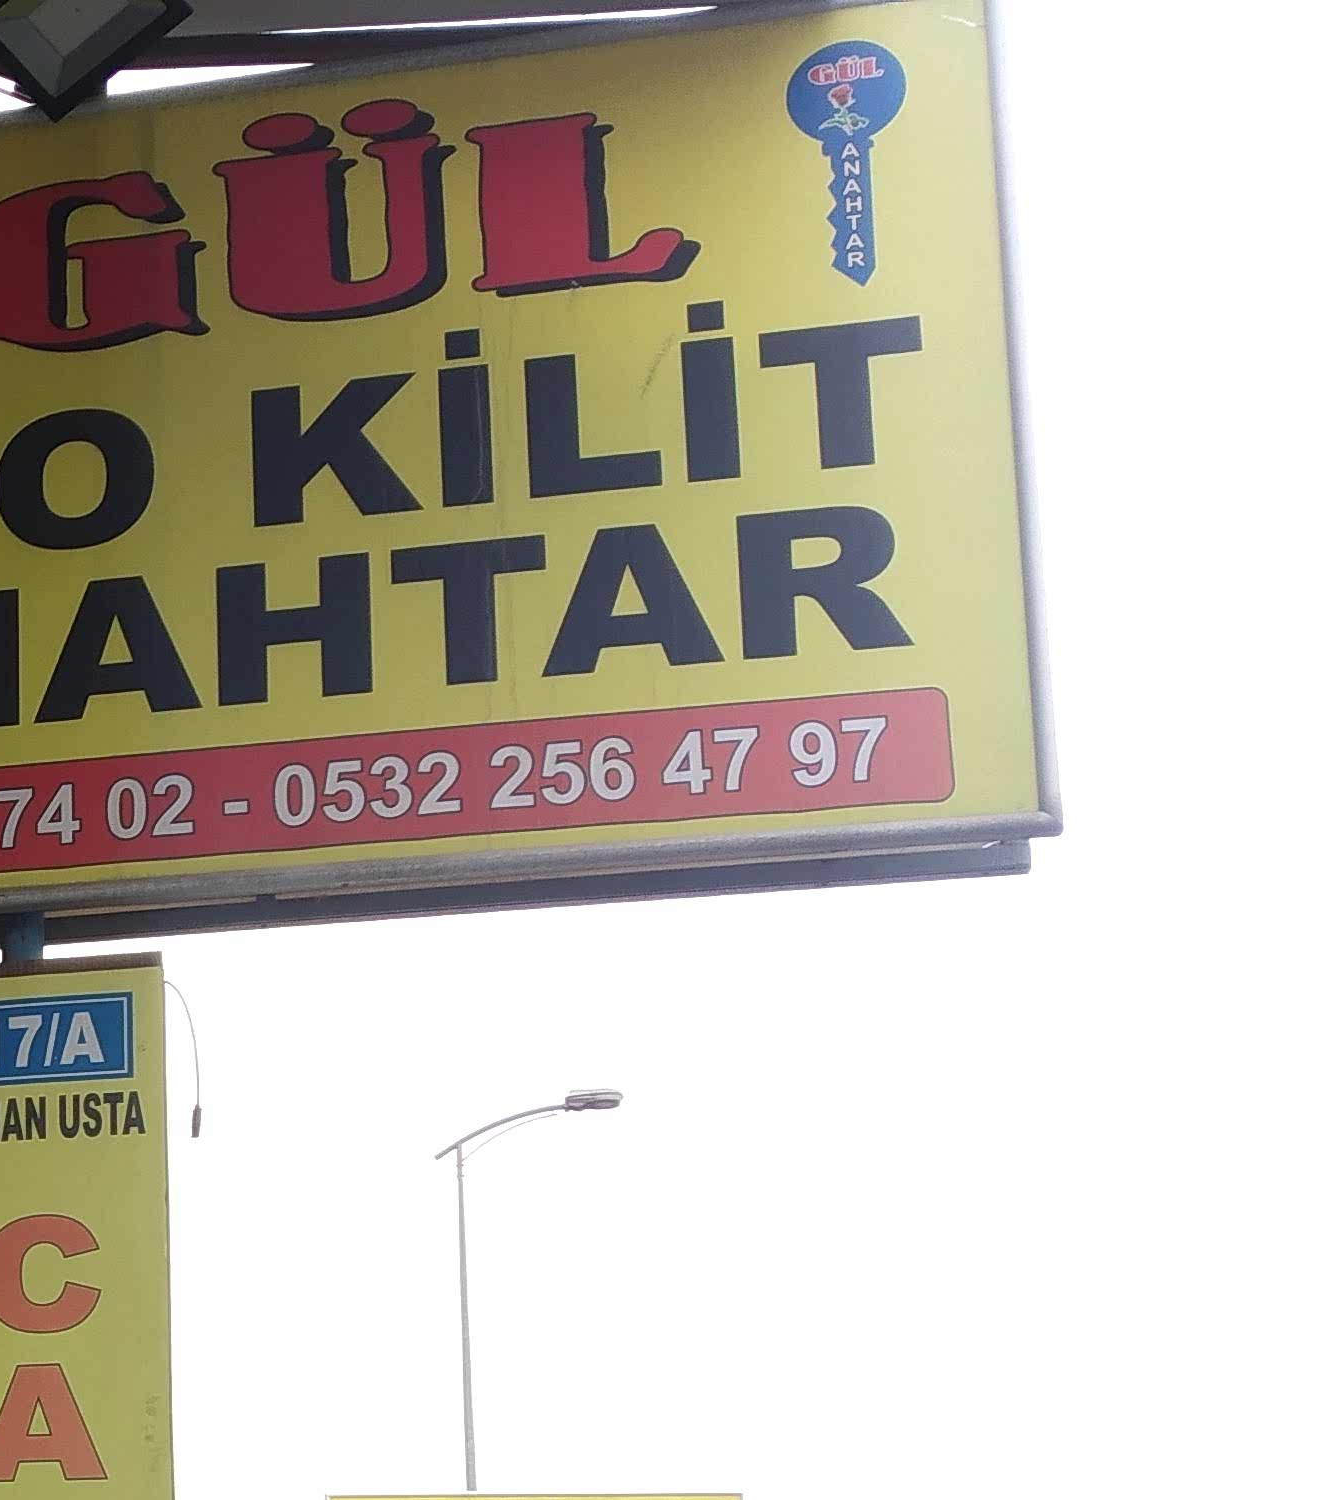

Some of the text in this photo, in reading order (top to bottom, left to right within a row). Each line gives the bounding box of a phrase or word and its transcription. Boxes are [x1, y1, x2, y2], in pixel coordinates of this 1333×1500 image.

[808, 55, 884, 86] GÜL
[841, 142, 864, 267] ANAHTAR
[251, 301, 921, 528] KİLİT
[105, 772, 195, 841] 02
[273, 751, 460, 831] 0532
[490, 735, 635, 809] 256
[661, 723, 754, 794] 47
[788, 714, 888, 786] 97
[58, 1090, 146, 1139] USTA
